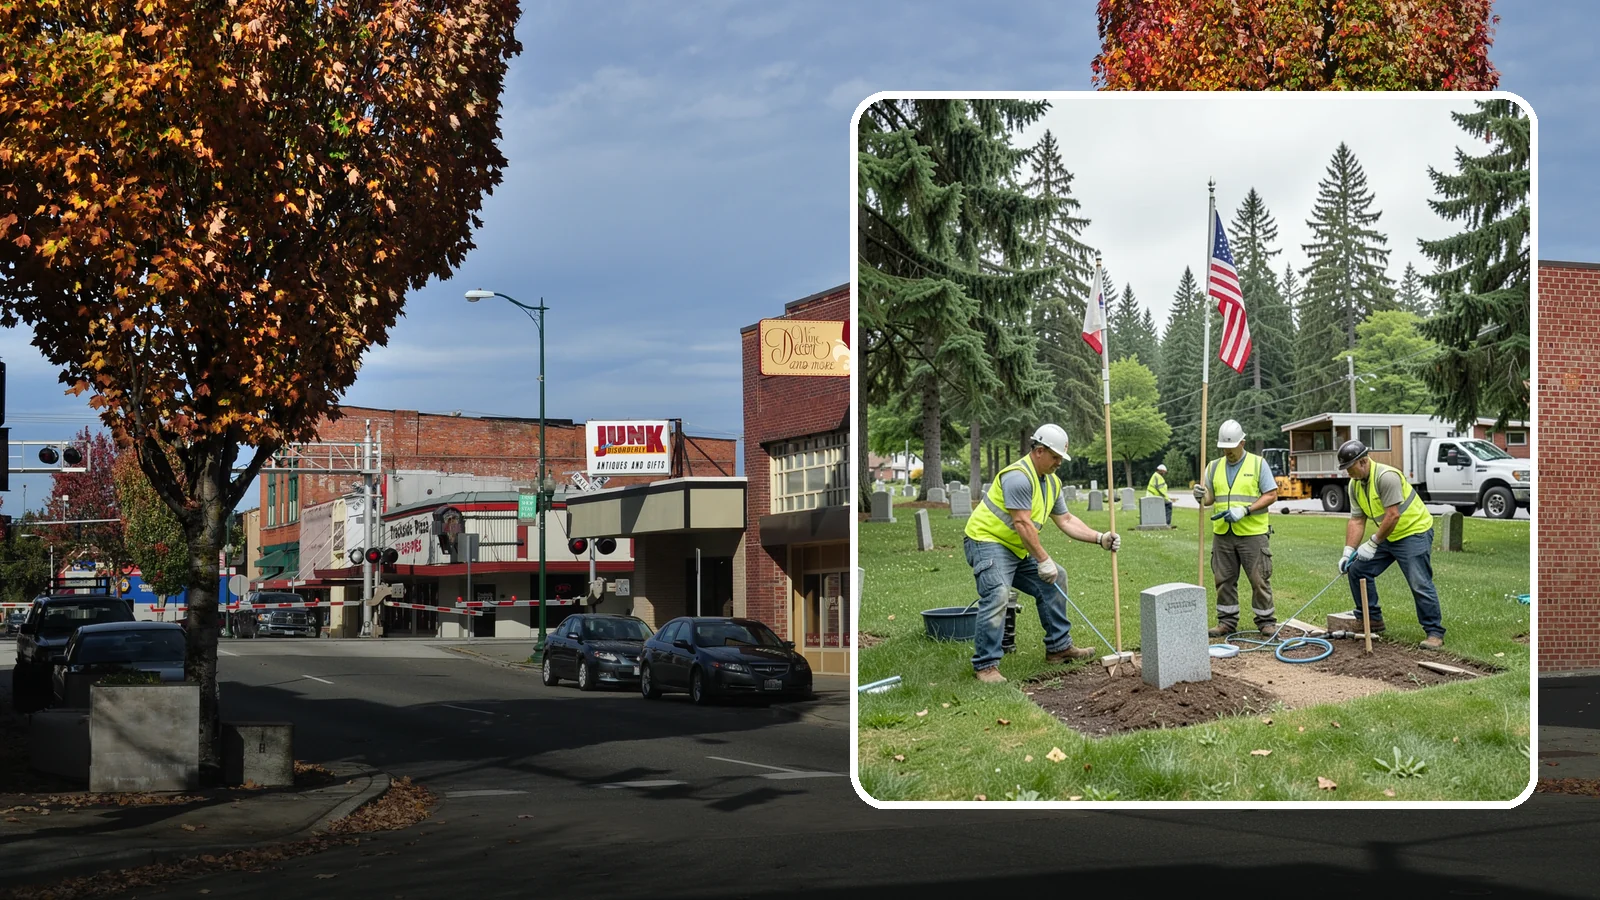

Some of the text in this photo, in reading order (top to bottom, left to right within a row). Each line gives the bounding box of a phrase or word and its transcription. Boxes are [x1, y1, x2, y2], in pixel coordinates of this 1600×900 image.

[595, 425, 665, 457] JUNK
[607, 446, 646, 454] DISORDERLY
[597, 460, 665, 470] ANTIQUES AND GIFTS
[573, 473, 589, 492] RAIL
[590, 476, 608, 491] SING
[414, 520, 429, 534] Pizza
